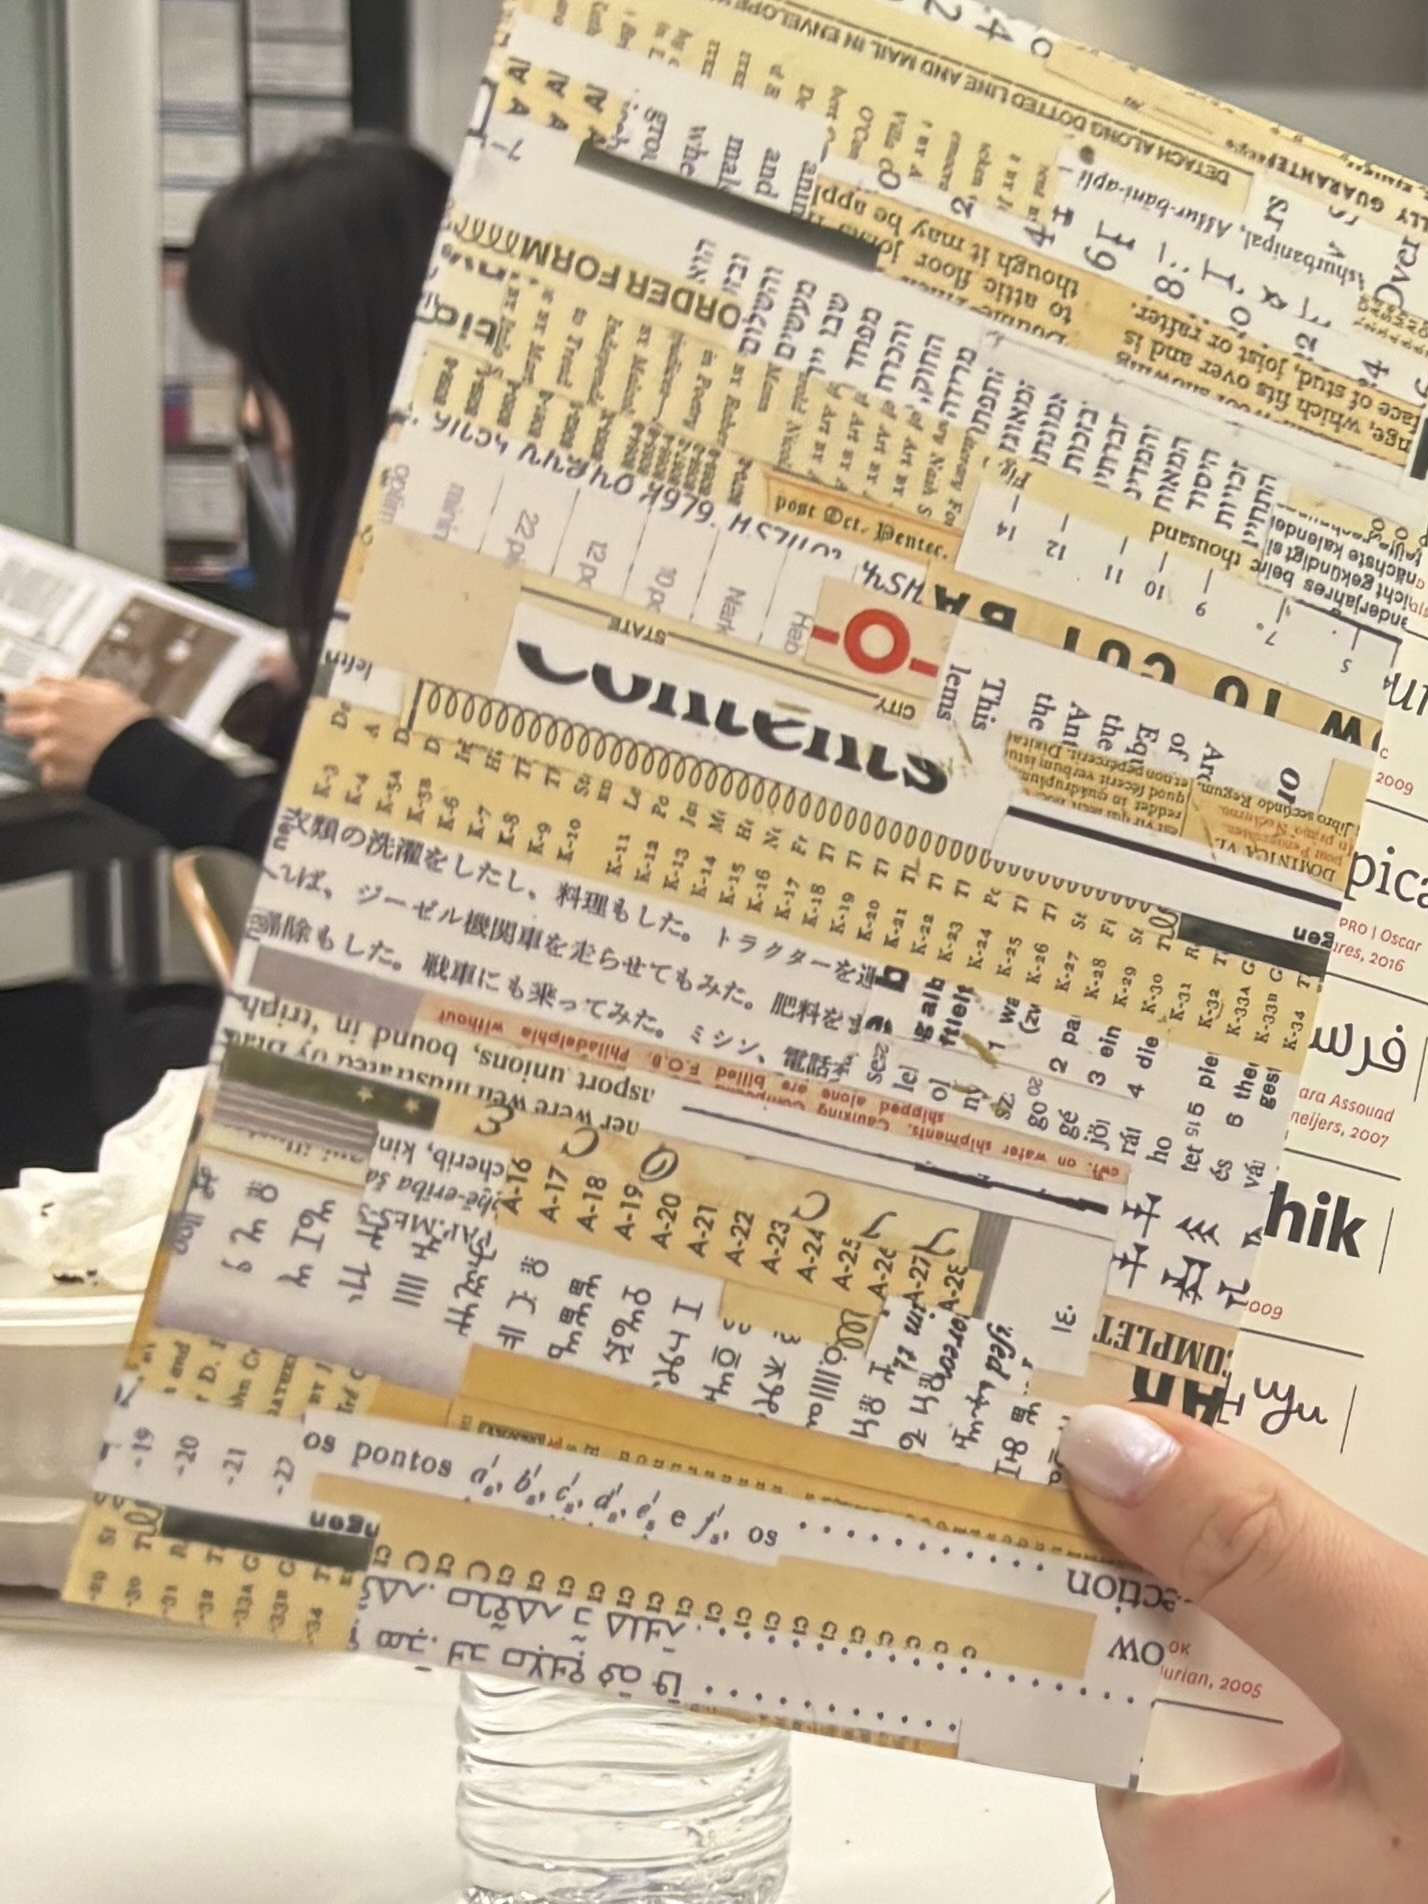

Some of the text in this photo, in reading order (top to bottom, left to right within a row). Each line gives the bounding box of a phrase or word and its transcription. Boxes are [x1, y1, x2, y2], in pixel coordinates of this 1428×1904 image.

[753, 146, 781, 199] and
[872, 205, 903, 238] be
[909, 217, 966, 253] may
[969, 241, 991, 268] it
[518, 235, 740, 329] ORDER FORM
[912, 251, 1072, 326] to attic floor
[996, 250, 1079, 299] though
[1129, 300, 1203, 342] rafter.
[1116, 327, 1145, 359] is
[1148, 337, 1194, 367] and
[1205, 332, 1234, 354] or
[1197, 358, 1251, 390] over
[1237, 344, 1289, 381] joist
[1293, 362, 1347, 399] stud,
[1255, 380, 1292, 412] fits
[1347, 389, 1374, 412] of
[1295, 396, 1361, 434] which
[1044, 538, 1067, 561] 12
[1148, 519, 1242, 571] thousand
[1103, 563, 1124, 585] 11
[1143, 579, 1166, 601] 10
[606, 610, 670, 646] STATE
[935, 663, 972, 727] lems
[970, 677, 1006, 731] This
[1027, 691, 1057, 731] the
[1096, 712, 1125, 752] the
[1167, 731, 1190, 763] of
[1374, 770, 1414, 796] 2009
[1379, 927, 1422, 952] Oscar
[1024, 941, 1049, 985] K-26
[1082, 956, 1107, 1000] K-28
[1367, 951, 1406, 972] 2016
[1111, 965, 1137, 1008] K-29
[1139, 972, 1164, 1015] K-30
[334, 1009, 364, 1044] in
[437, 1009, 503, 1036] without
[370, 1019, 458, 1067] bound
[1327, 1092, 1395, 1123] Assouad
[1001, 1143, 1047, 1162] water
[1348, 1125, 1390, 1148] 2007
[537, 1164, 568, 1225] A-17
[575, 1174, 607, 1234] A-18
[612, 1182, 644, 1242] A-19
[649, 1192, 682, 1250] A-20
[685, 1203, 718, 1258] A-21
[1263, 1179, 1365, 1257] hik
[723, 1209, 755, 1268] A-22
[759, 1218, 791, 1276] A-23
[301, 1430, 336, 1454] os
[350, 1440, 452, 1478] pontos
[1162, 1663, 1263, 1699] urian, 2005
